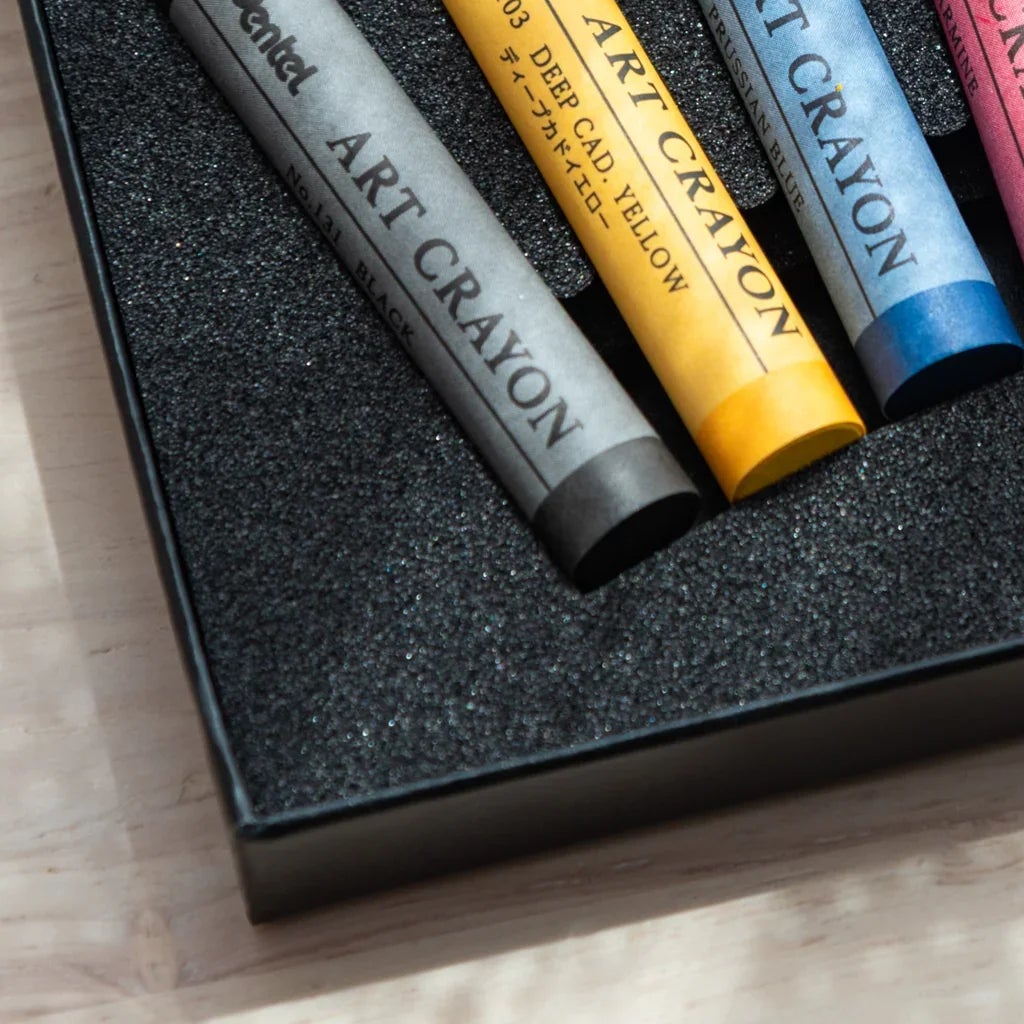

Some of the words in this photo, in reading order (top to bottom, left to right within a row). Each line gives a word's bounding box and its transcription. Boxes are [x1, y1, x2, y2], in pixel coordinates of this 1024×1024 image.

[500, 46, 609, 229] ディープカドイエロー
[529, 44, 579, 110] DEEP
[574, 118, 614, 183] CAD.
[614, 184, 689, 295] YELLOW
[582, 15, 667, 111] ART
[659, 130, 803, 337] CRAYON
[709, 3, 770, 135] PRUSSIAN
[770, 142, 804, 213] BLUE
[789, 53, 917, 277] CRAYON
[286, 164, 342, 243] No.131
[355, 261, 413, 346] BLACK
[327, 132, 427, 230] ART
[413, 238, 585, 450] CRAYON
